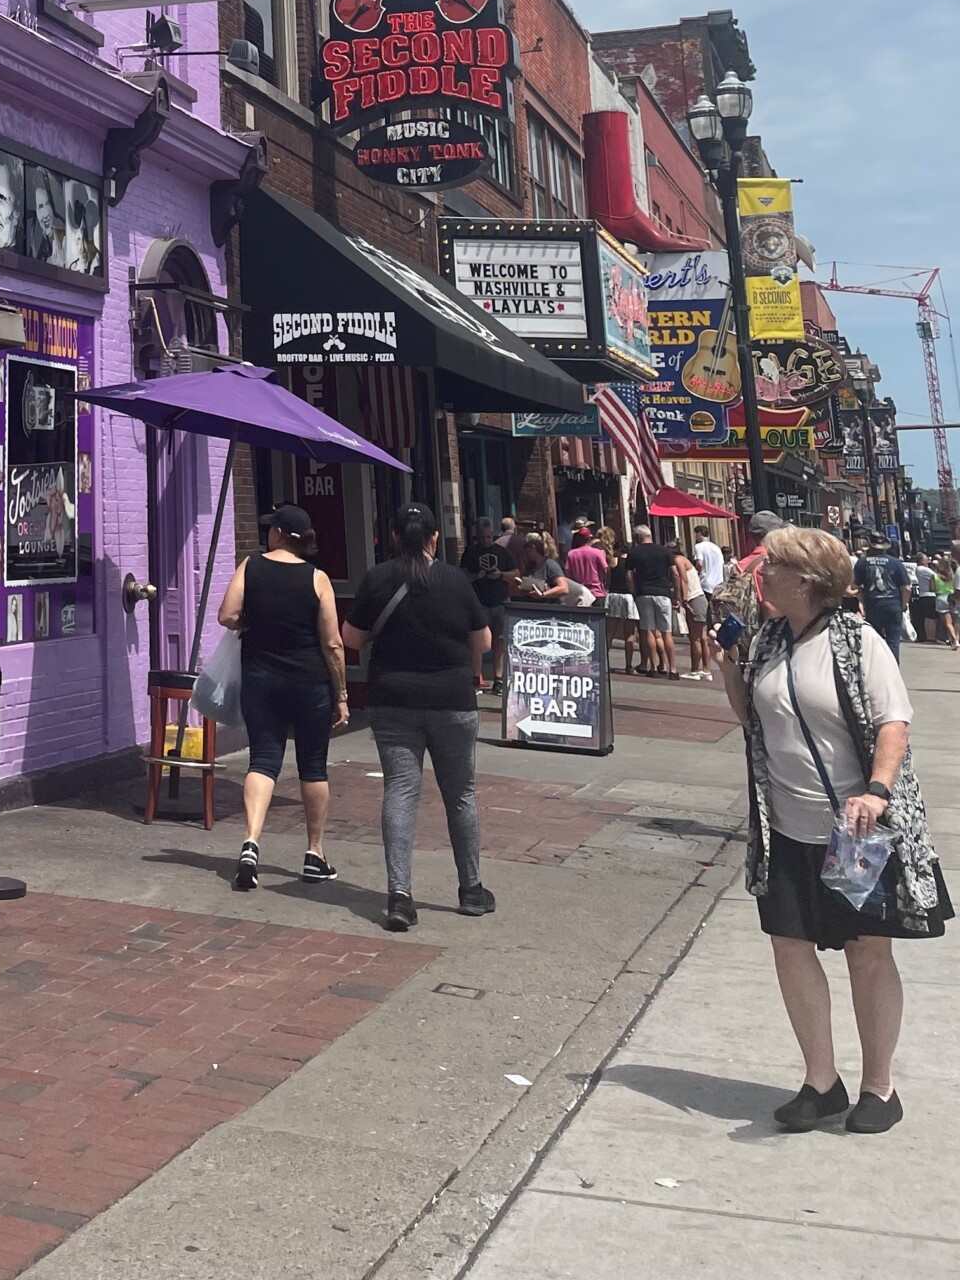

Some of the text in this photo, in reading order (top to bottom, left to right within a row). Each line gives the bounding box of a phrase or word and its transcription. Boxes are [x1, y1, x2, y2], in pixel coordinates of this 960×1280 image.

[387, 11, 436, 34] THE
[322, 27, 509, 80] SECOND
[332, 66, 503, 121] FIDDLE
[386, 121, 450, 141] MUSIC
[356, 142, 484, 165] HONKY TONK
[396, 164, 444, 184] CITY
[469, 263, 568, 279] WELCOME TO
[643, 255, 711, 290] ert's
[474, 281, 566, 297] NASHVILLE &
[753, 291, 792, 304] 8 SECONDS
[492, 299, 556, 314] LAYLA'S
[43, 312, 78, 360] FAMOUS
[272, 312, 397, 350] SECOND FIDDLE
[277, 353, 395, 362] ROOFTOP BAR LIVE MUSIC PIZZA
[668, 350, 685, 371] of
[652, 394, 692, 404] Heaven
[8, 465, 57, 525] Tootsies
[304, 476, 335, 496] BAR
[18, 539, 56, 555] LOUNGE
[517, 625, 591, 650] SECOND FIDDLE
[514, 671, 593, 699] ROOFTOP
[530, 697, 578, 719] BAR
